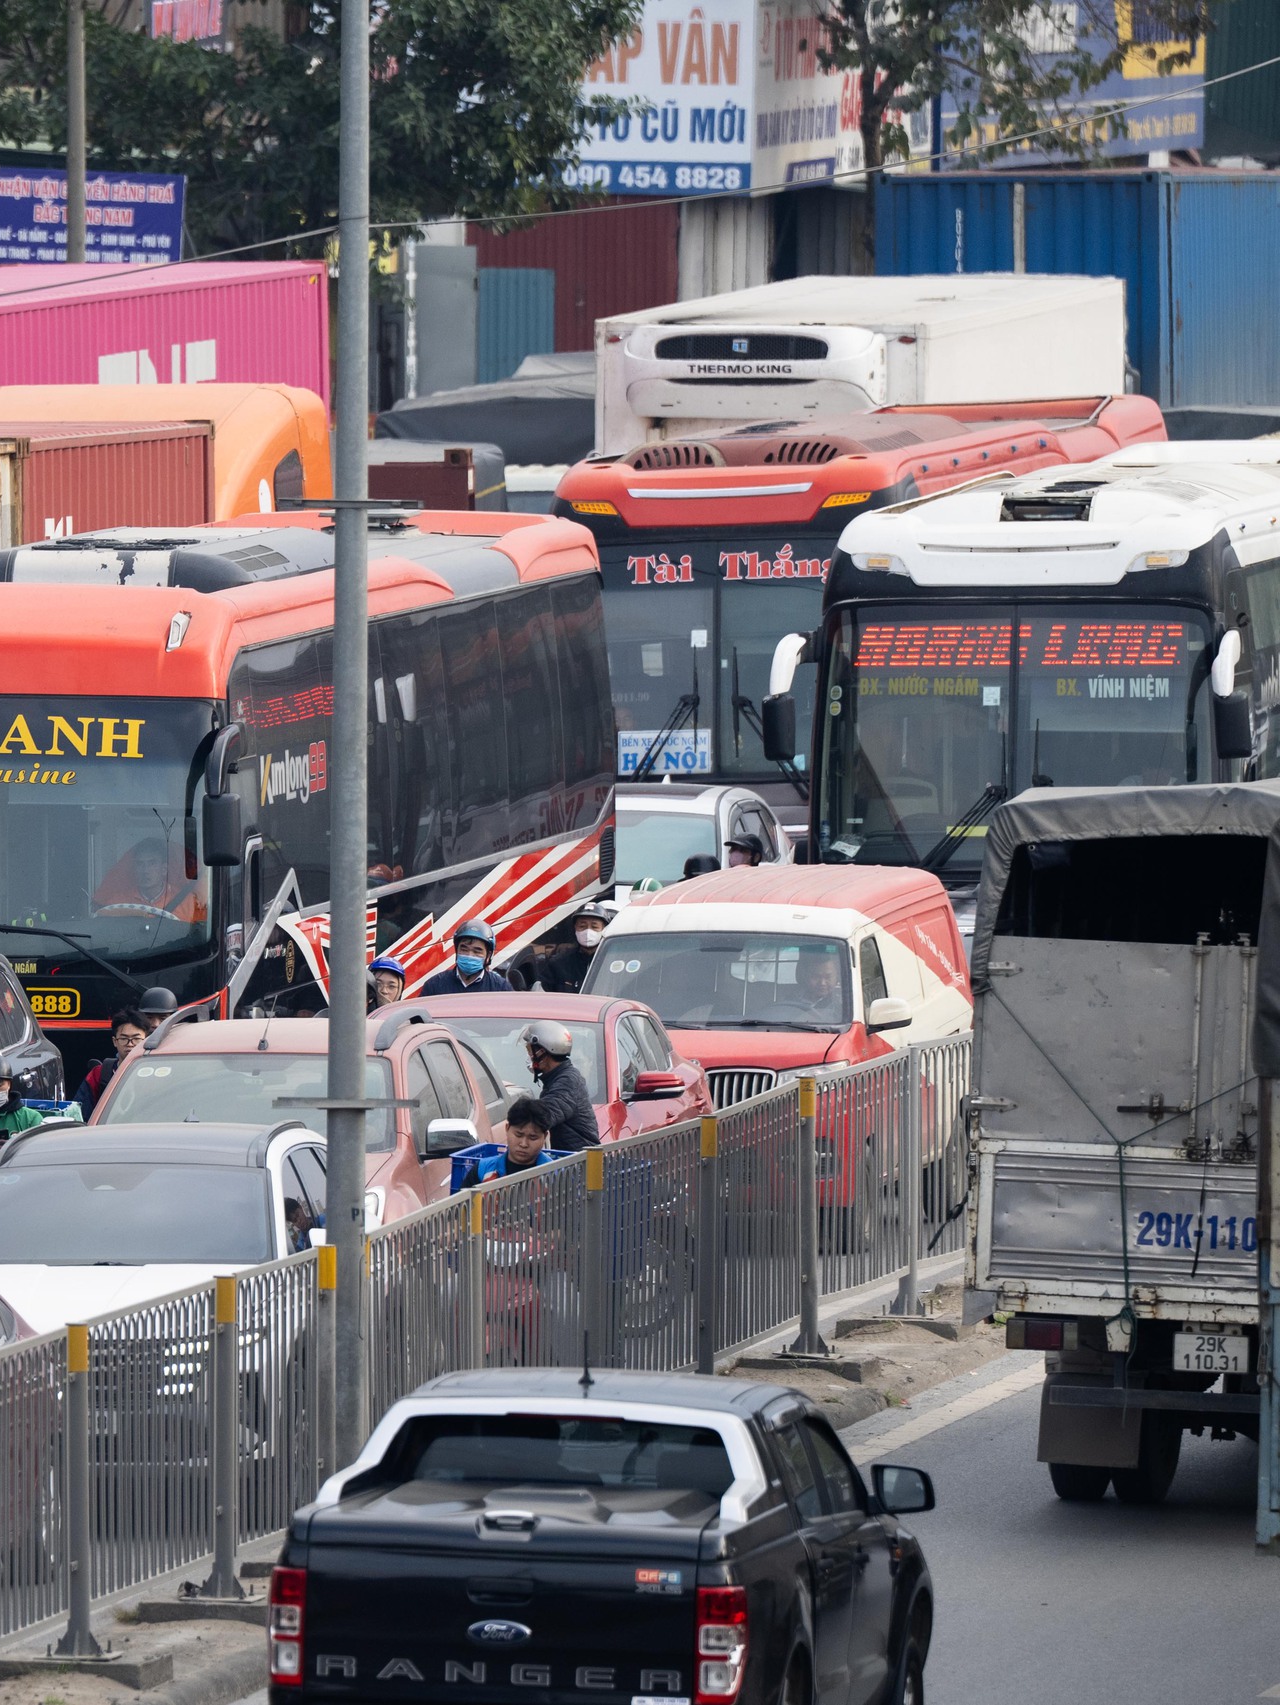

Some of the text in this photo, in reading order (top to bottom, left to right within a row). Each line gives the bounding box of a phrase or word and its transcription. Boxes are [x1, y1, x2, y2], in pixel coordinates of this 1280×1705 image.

[657, 7, 739, 86] VÂN
[641, 100, 679, 143] CŨ
[689, 101, 746, 144] MỚI
[617, 164, 669, 189] 454
[674, 166, 742, 190] 8828
[111, 181, 145, 202] HÀNG
[103, 208, 134, 227] NAM
[688, 364, 792, 374] THERMO KING
[627, 553, 694, 585] Tài
[859, 678, 883, 696] BX.
[1056, 678, 1082, 697] BX.
[1088, 673, 1126, 699] VĨNH
[1129, 676, 1171, 701] NIỆM
[621, 735, 639, 747] BẾN
[640, 738, 652, 747] XE
[664, 746, 707, 774] NỘI
[30, 995, 71, 1013] 888
[1195, 1336, 1226, 1353] 29K
[1183, 1355, 1239, 1372] 110.31
[480, 1624, 516, 1640] Ford
[316, 1654, 683, 1692] RANGER
